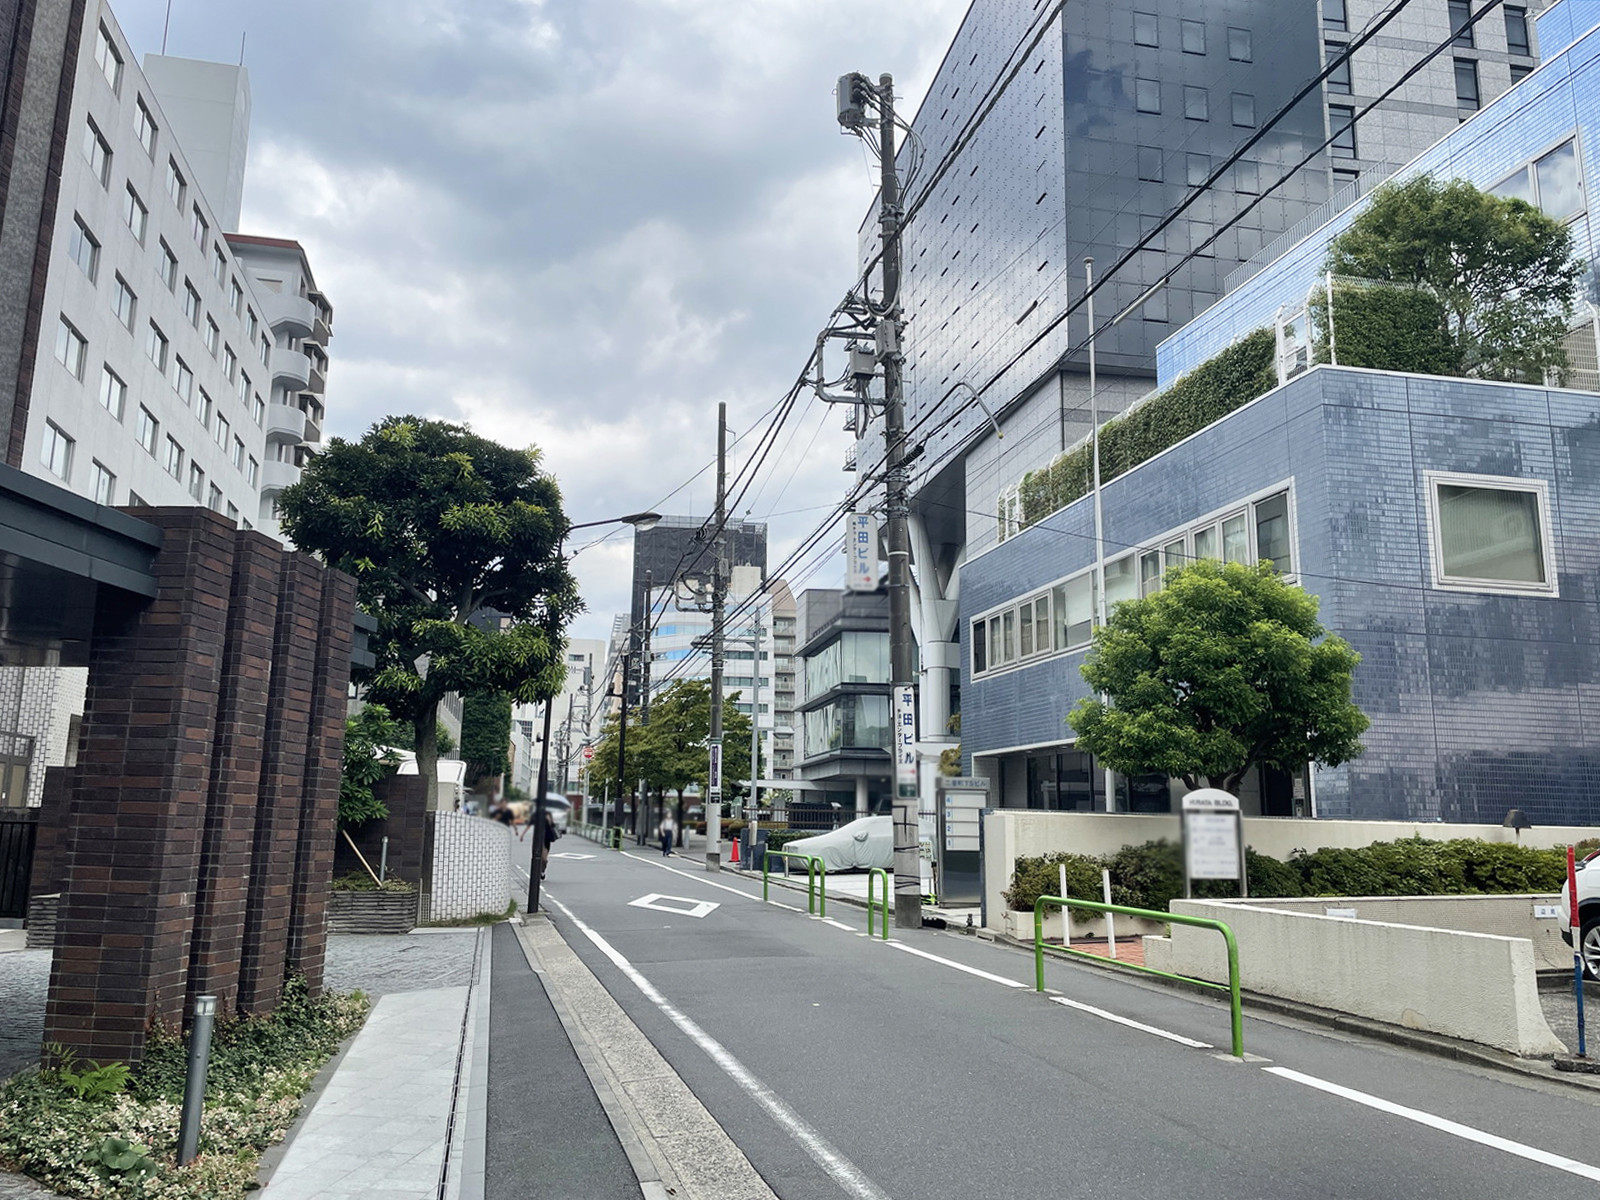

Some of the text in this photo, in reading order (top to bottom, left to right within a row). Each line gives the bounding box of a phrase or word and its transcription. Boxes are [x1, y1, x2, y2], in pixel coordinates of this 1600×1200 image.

[858, 515, 869, 574] 平田ビル
[902, 693, 914, 764] 平田ビル
